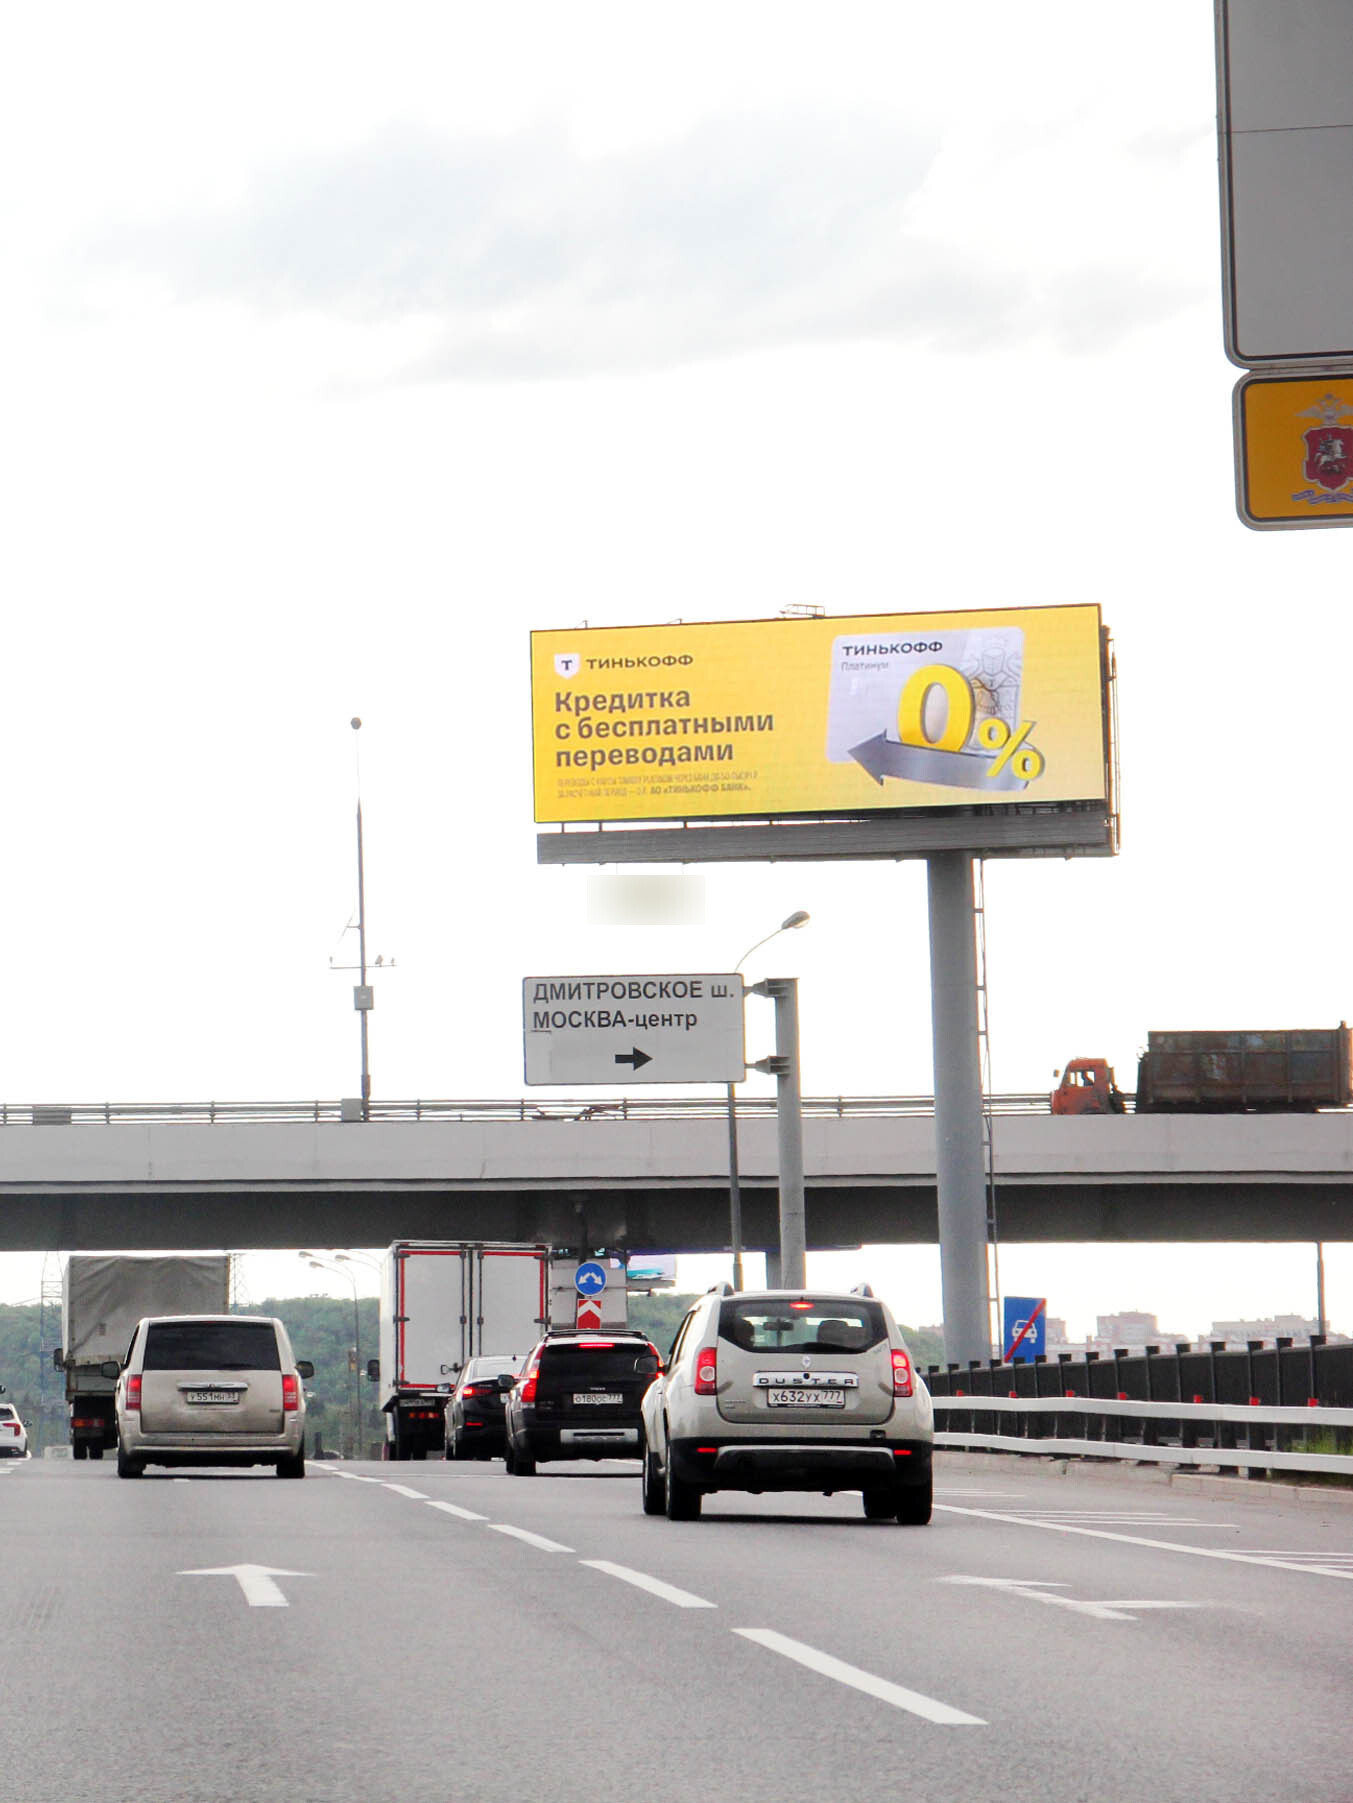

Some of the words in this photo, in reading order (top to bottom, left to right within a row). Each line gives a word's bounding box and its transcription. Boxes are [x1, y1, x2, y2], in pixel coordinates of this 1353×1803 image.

[842, 641, 943, 657] ТИНЬКОФФ
[586, 654, 694, 670] ТИНЬКОФФ
[555, 690, 691, 716] Кредитка
[555, 722, 571, 740] с
[577, 714, 774, 739] бесплатными
[556, 743, 734, 771] переводами
[533, 981, 703, 1003] ДМИТРОВСКОЕ
[533, 1010, 698, 1031] МОСКВА-центр
